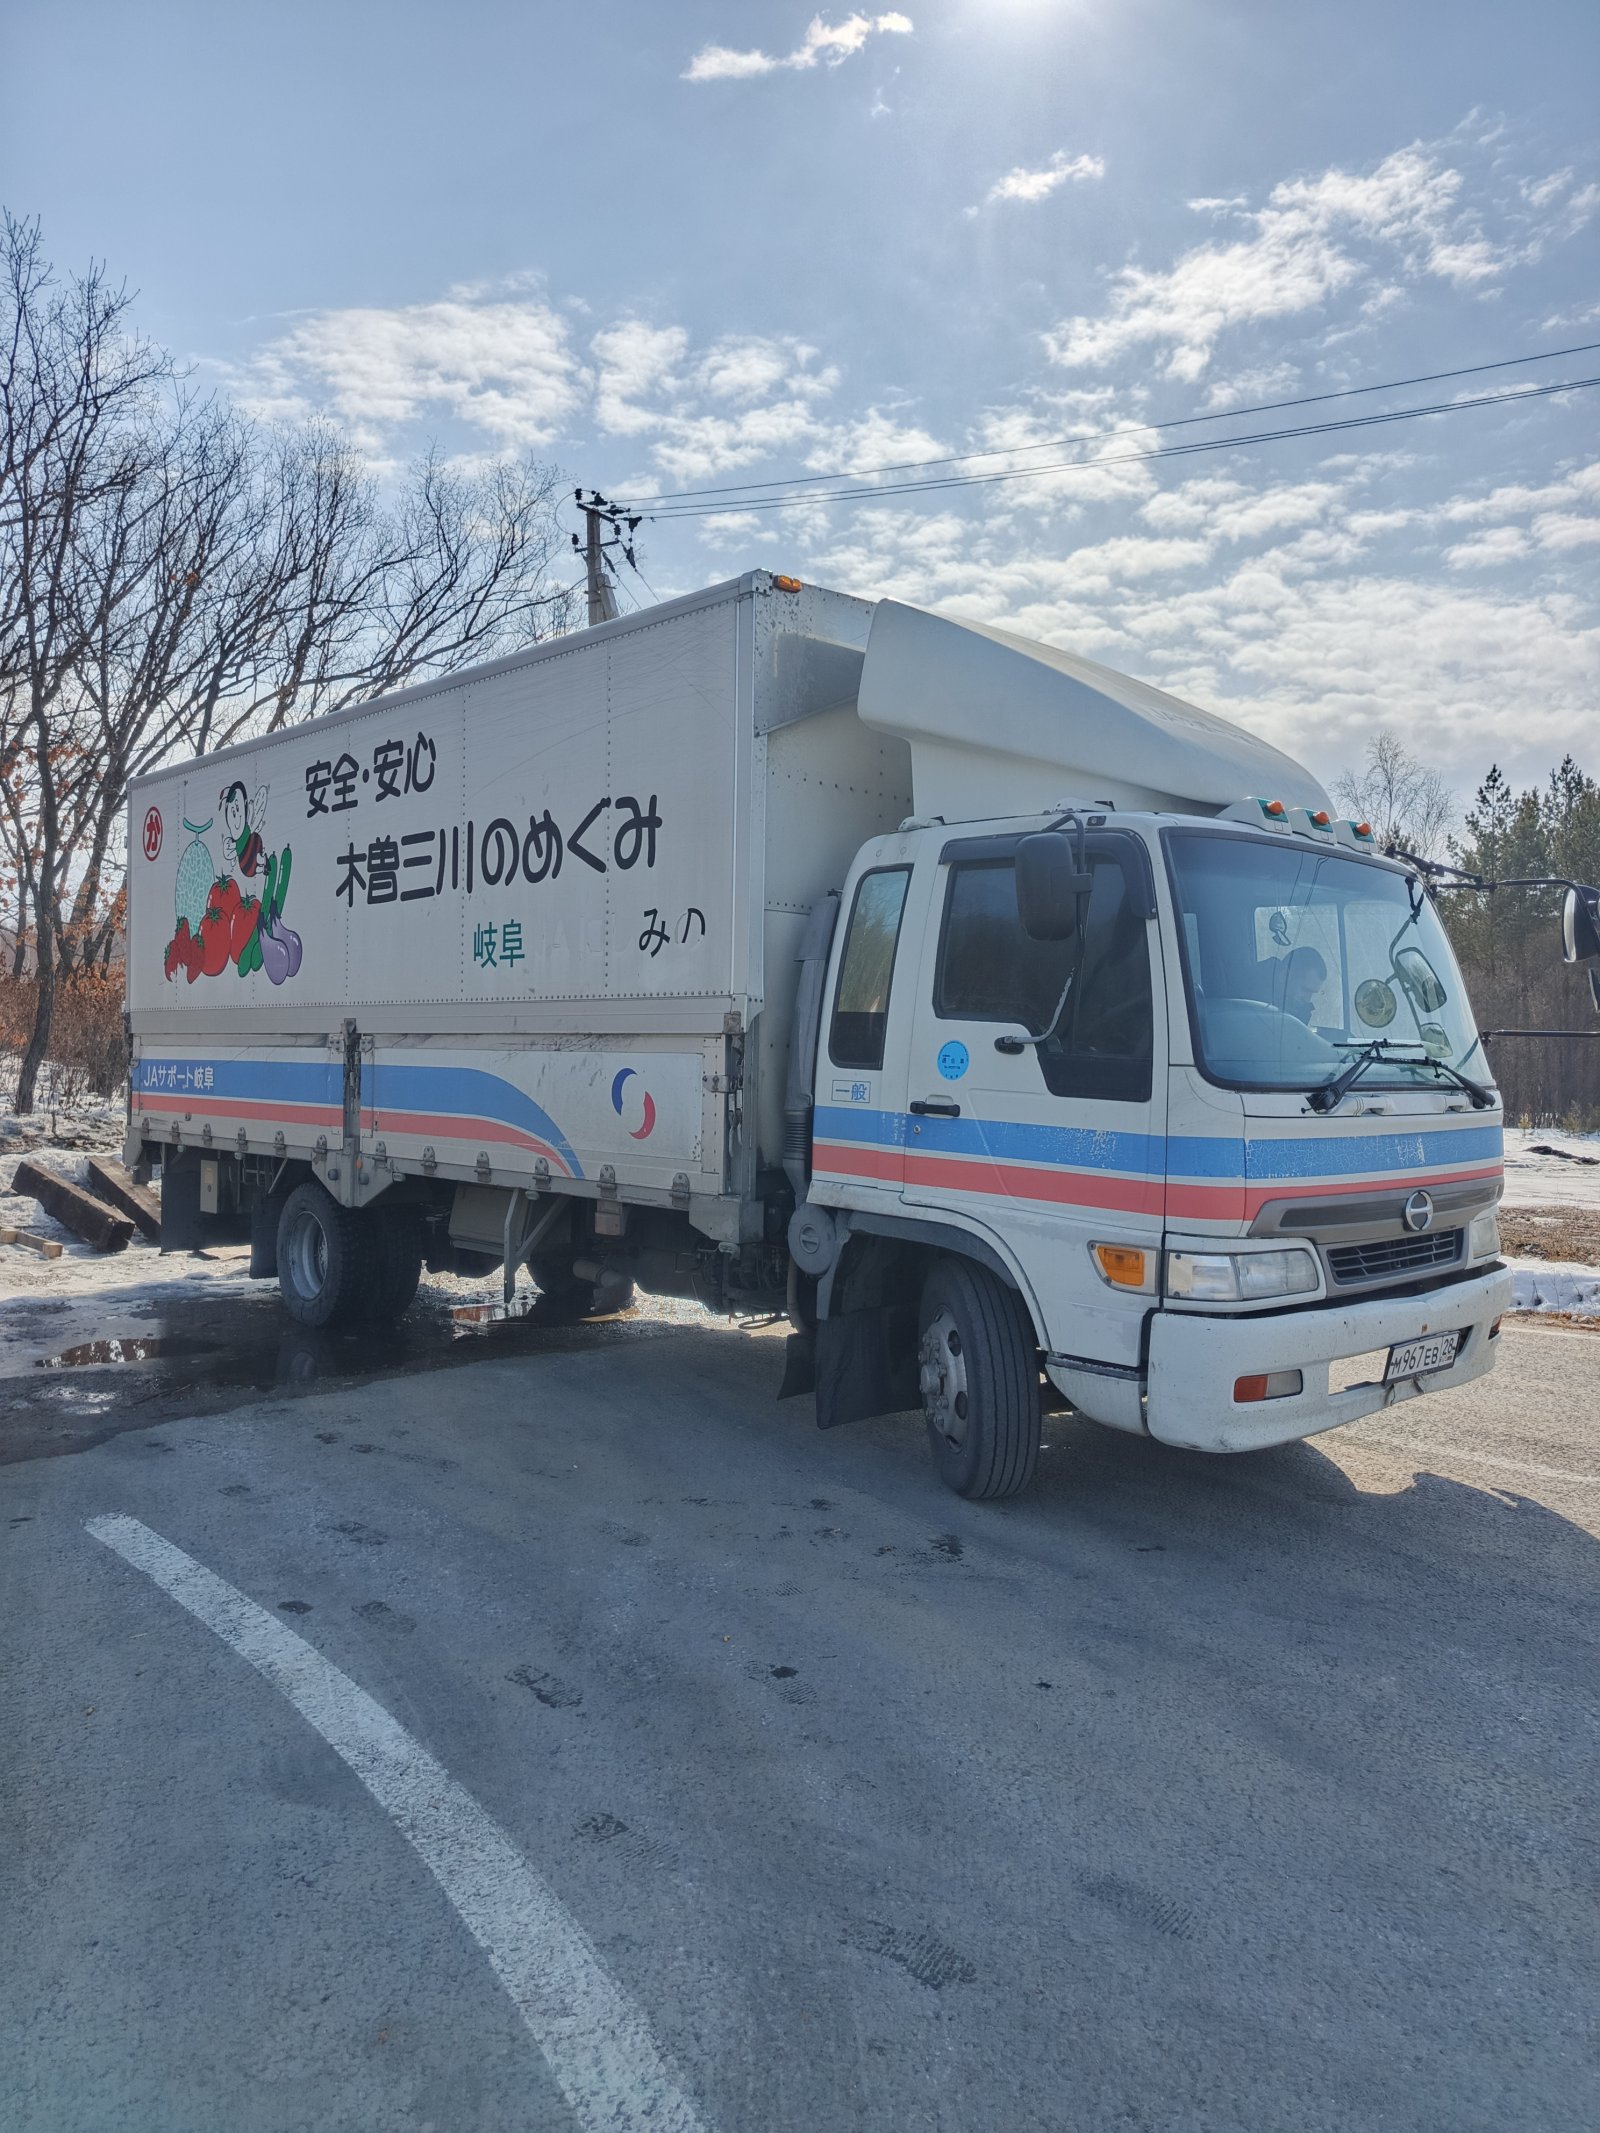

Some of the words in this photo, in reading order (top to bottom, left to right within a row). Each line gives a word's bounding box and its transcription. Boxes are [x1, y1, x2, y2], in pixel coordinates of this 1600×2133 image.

[306, 731, 437, 818] 安全・安心
[473, 918, 526, 968] 岐阜
[835, 1082, 867, 1101] 一般
[1442, 1337, 1455, 1356] 28
